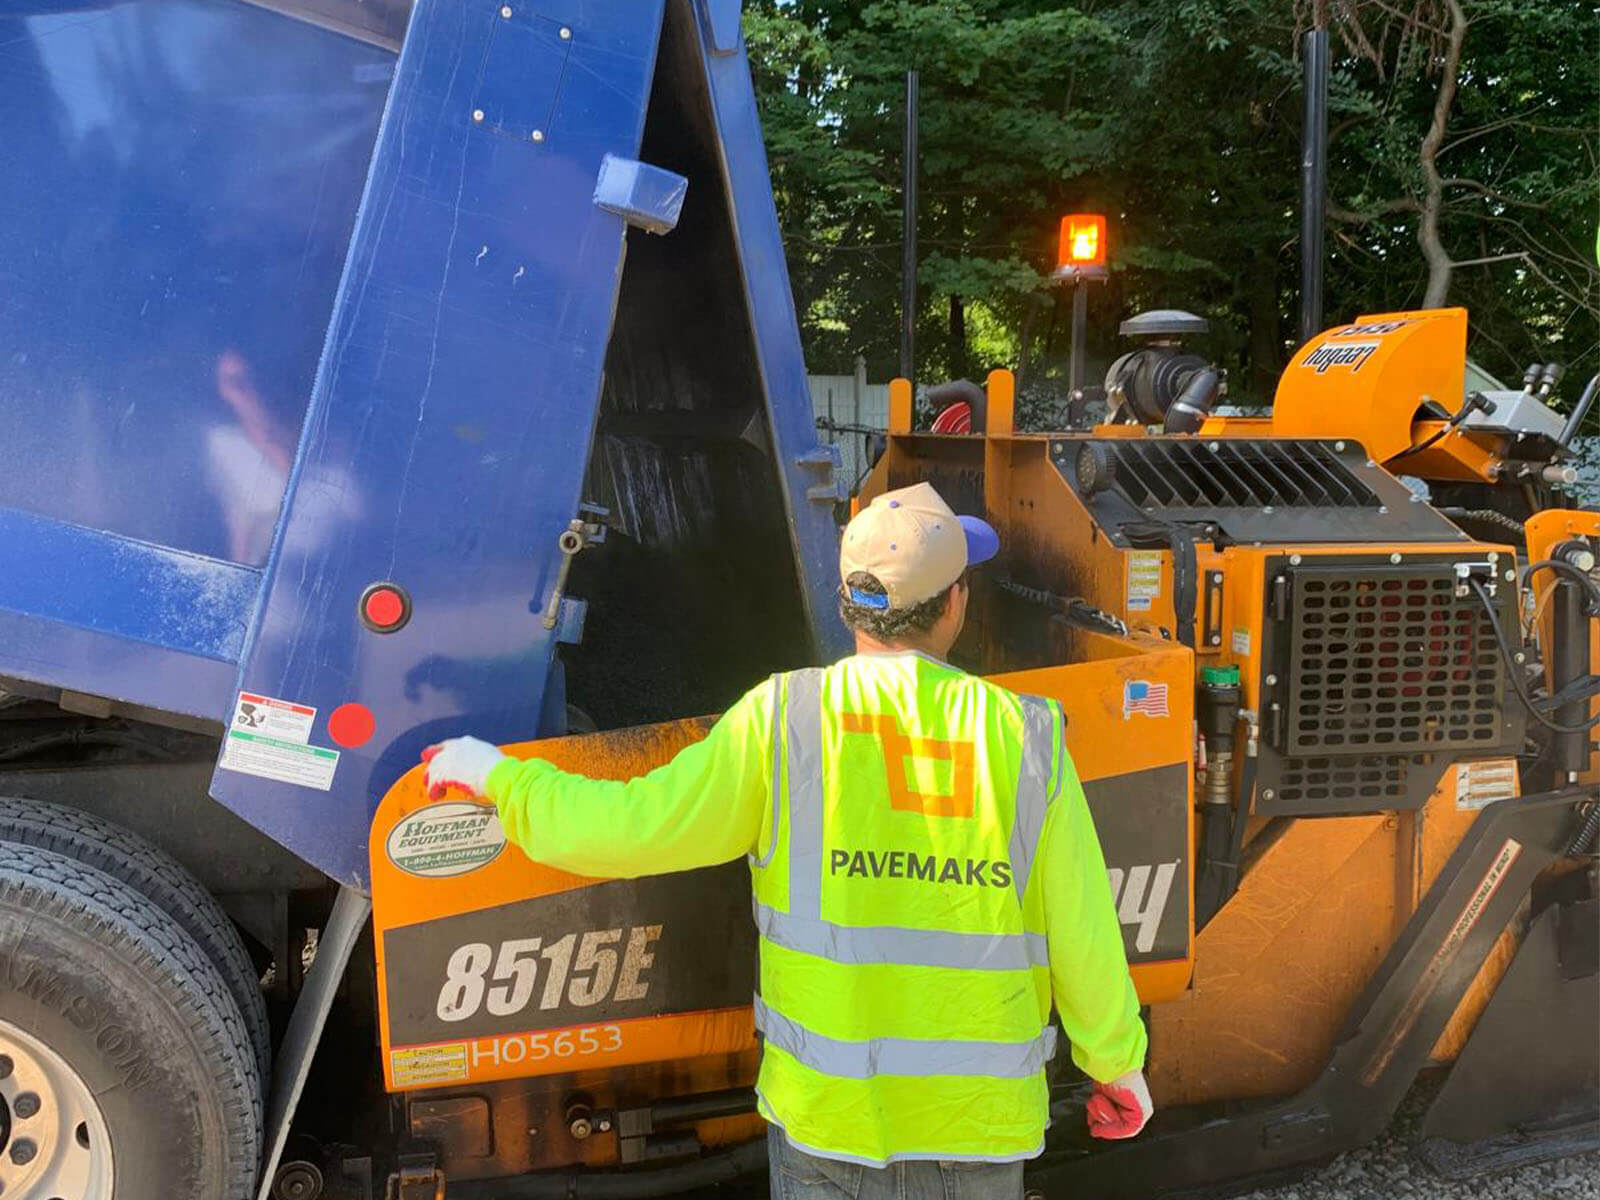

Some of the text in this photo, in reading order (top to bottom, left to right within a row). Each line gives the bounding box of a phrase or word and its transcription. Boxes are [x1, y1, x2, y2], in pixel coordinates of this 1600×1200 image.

[398, 828, 485, 848] EQUIPMENT
[831, 849, 1012, 888] PAVEMAKS
[437, 925, 663, 1022] 8515E
